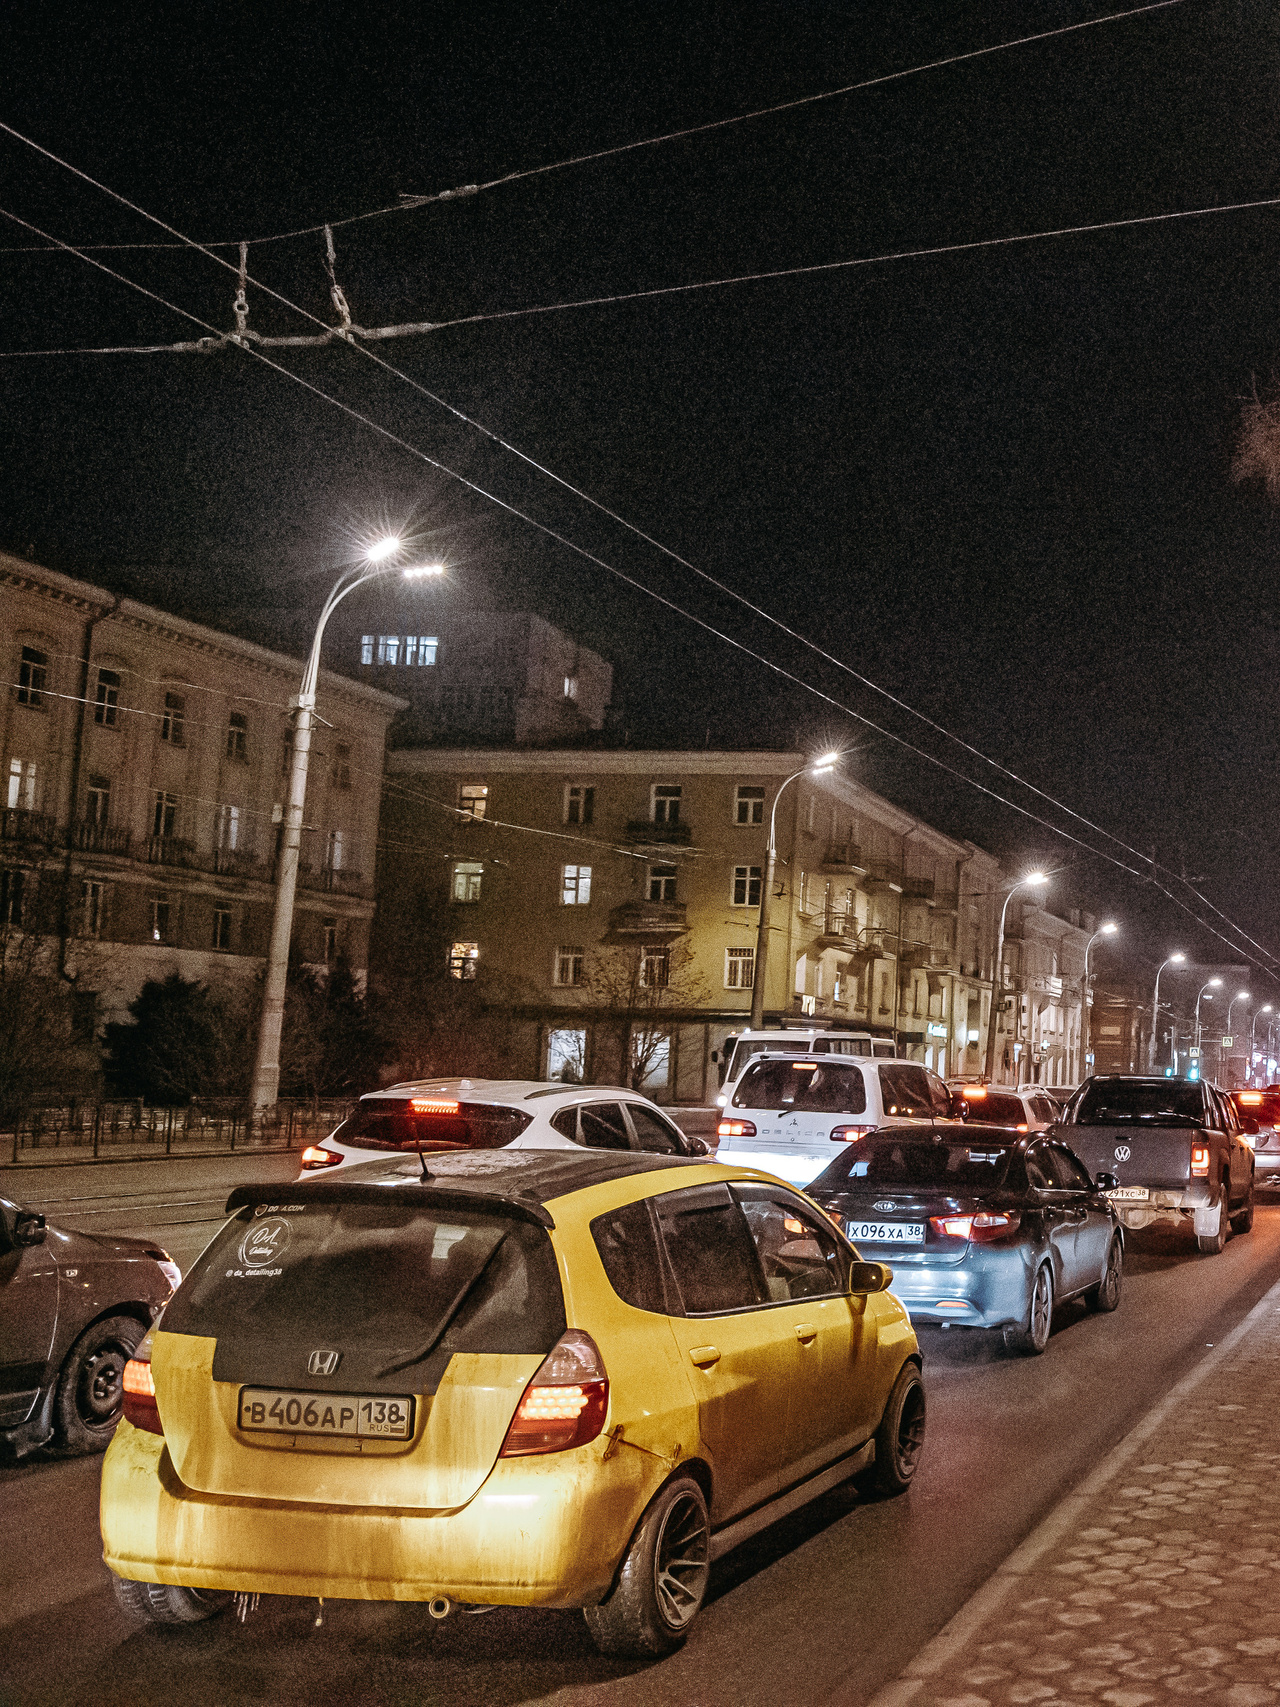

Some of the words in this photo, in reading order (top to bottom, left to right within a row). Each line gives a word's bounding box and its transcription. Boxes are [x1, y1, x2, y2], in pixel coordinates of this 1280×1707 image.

[1137, 1189, 1146, 1197] 38
[851, 1224, 904, 1239] Х096ХА
[907, 1225, 921, 1236] 38
[251, 1397, 354, 1428] В406АР
[361, 1402, 401, 1424] 138
[369, 1423, 390, 1432] RUS
